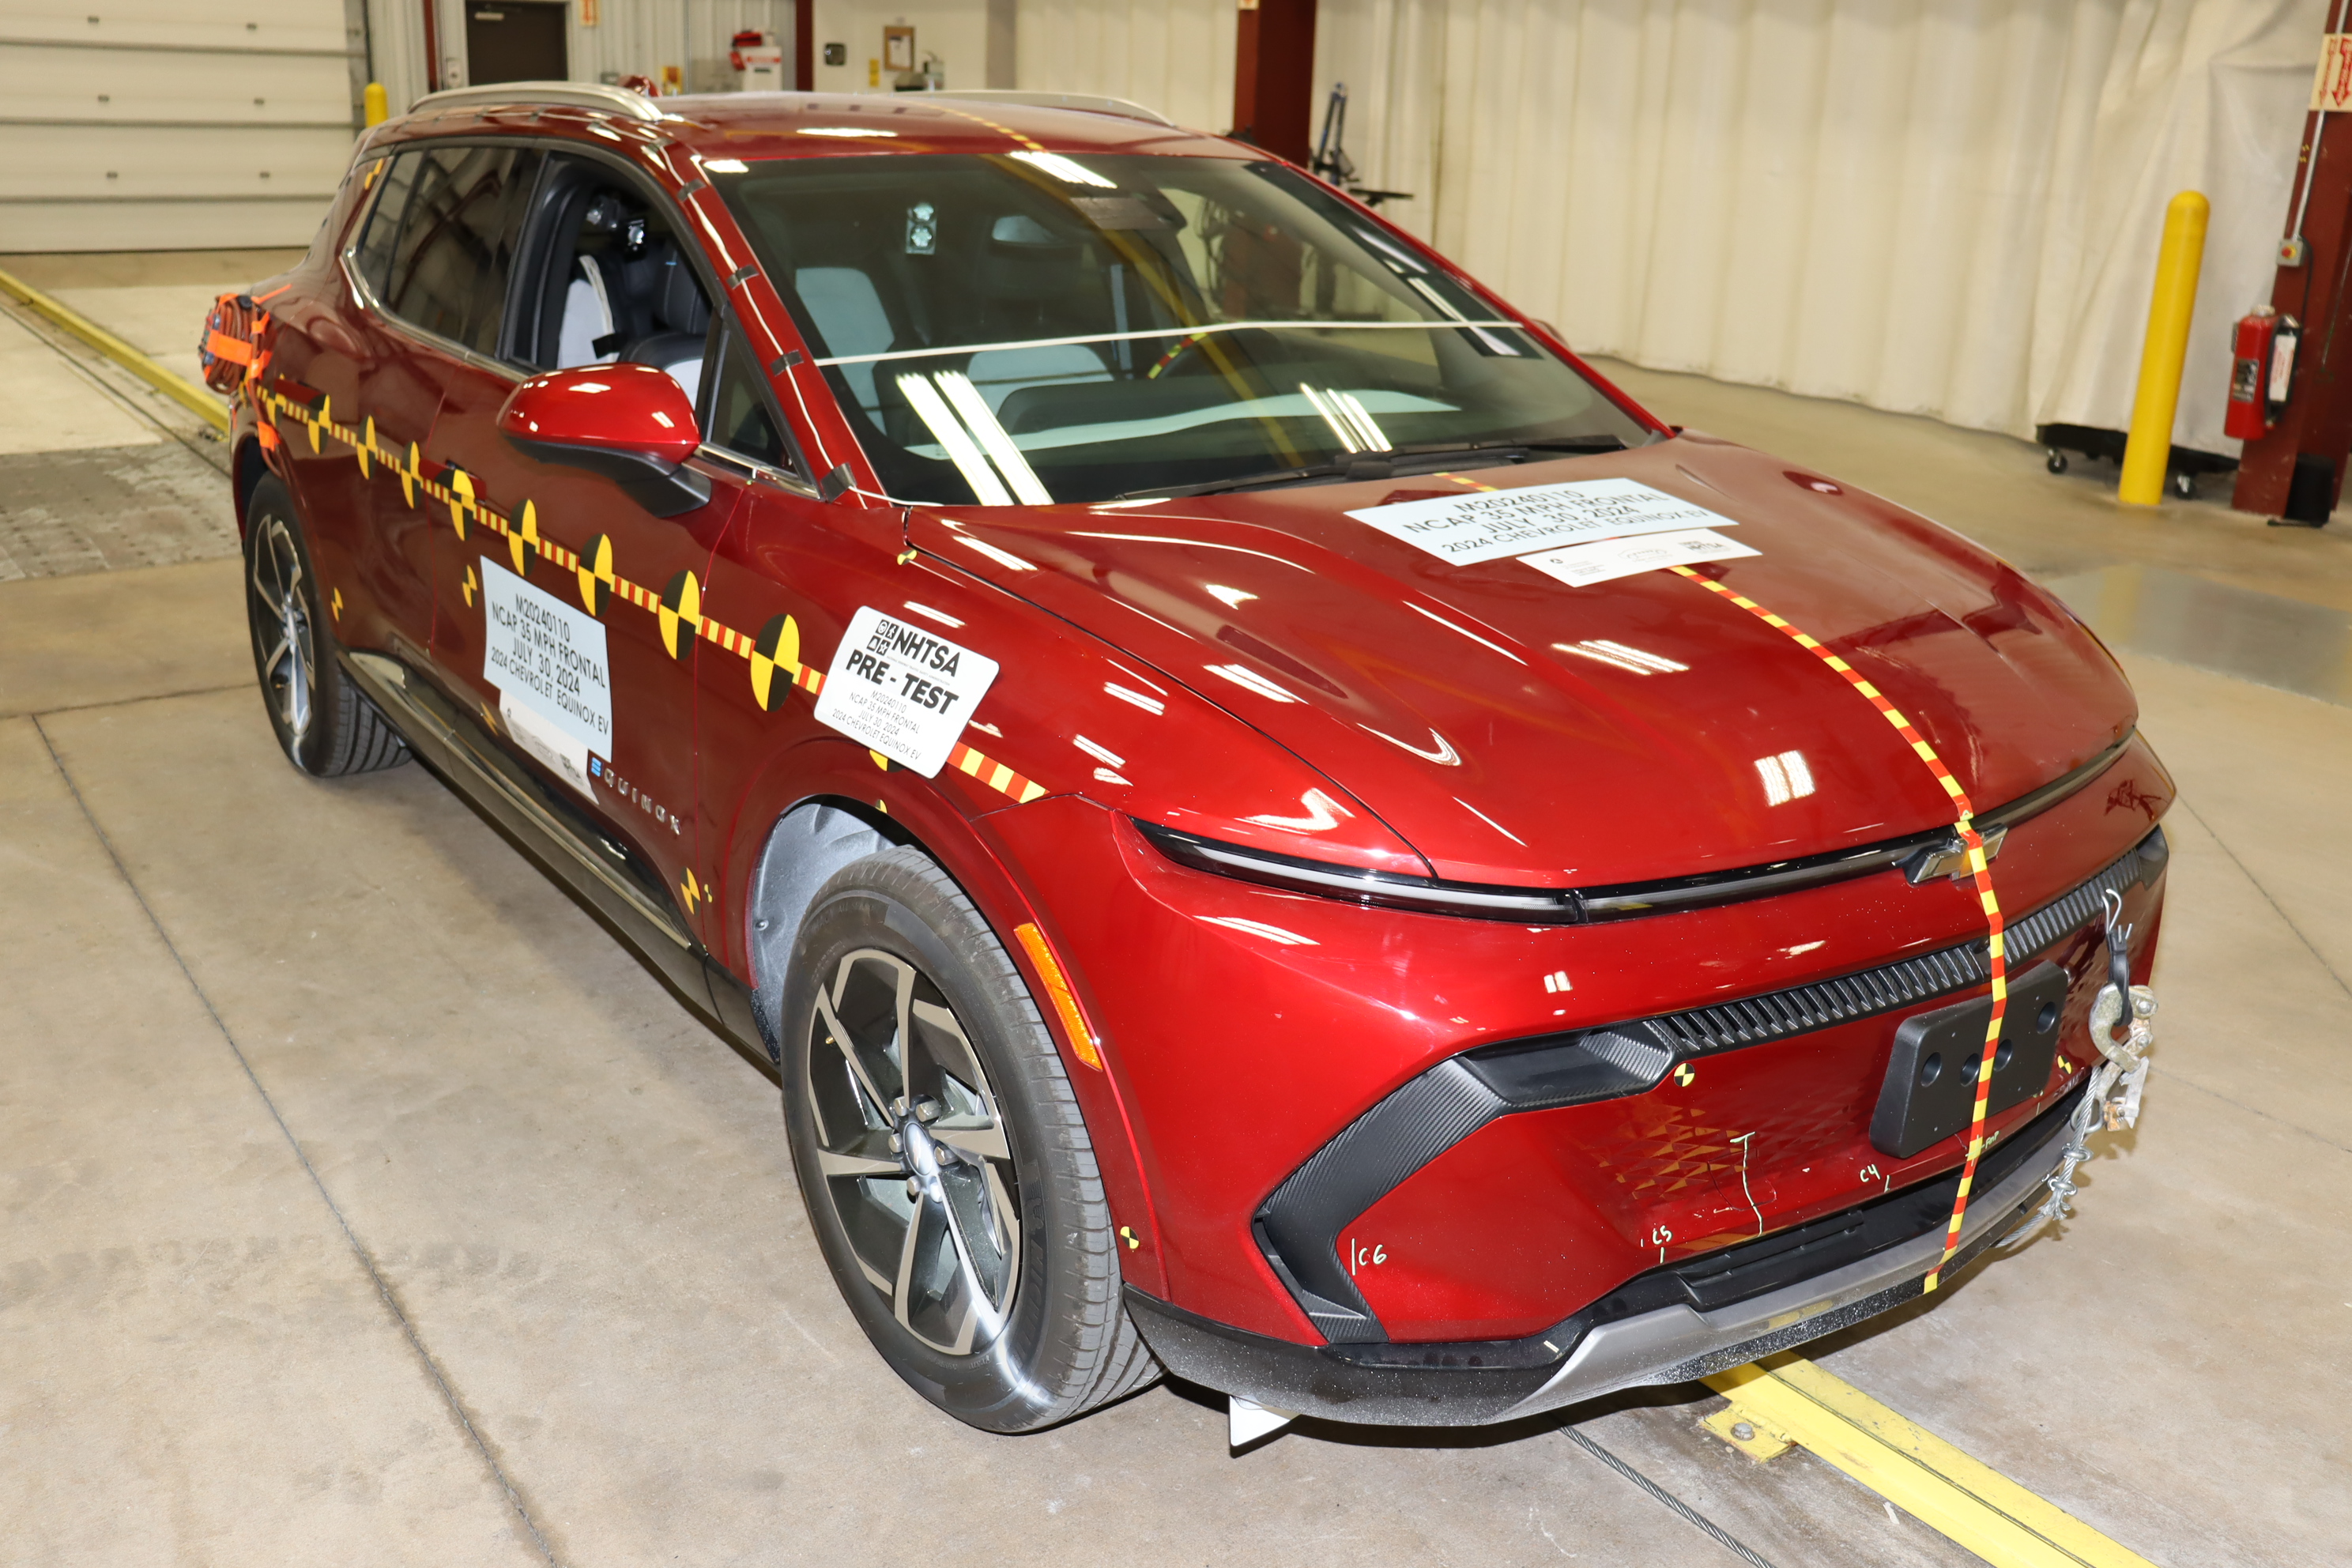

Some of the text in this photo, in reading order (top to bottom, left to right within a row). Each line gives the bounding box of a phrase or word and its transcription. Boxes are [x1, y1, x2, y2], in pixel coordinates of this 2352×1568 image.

[1402, 493, 1670, 533] NCAP 35 MPH FRONTAL
[1454, 490, 1585, 512] M20240110
[1481, 518, 1536, 533] JULY
[1582, 505, 1641, 518] 2024
[1442, 538, 1494, 552] 2024
[1493, 520, 1602, 542] CHEVROLET
[1604, 511, 1686, 526] EQUINOX
[516, 594, 571, 643] M20240110
[492, 601, 606, 688] NCAP 35 MPH FRONTAL
[892, 628, 960, 677] NHTSA
[513, 637, 580, 696] JULY 30, 2024
[846, 649, 891, 686] PRE
[901, 673, 959, 715] TEST
[491, 646, 609, 736] 2024 CHEVROLET EQUINOX EV
[870, 690, 907, 714] M20240110
[849, 692, 920, 734] NCAP 35 MPH FRONTAL
[858, 710, 874, 722] JULY
[883, 722, 900, 737] 2024
[832, 708, 922, 760] 2024 CHEVROLET EQUINOX EV
[1860, 1164, 1881, 1183] C4
[1358, 1244, 1387, 1266] C6
[1652, 1225, 1672, 1245] C5
